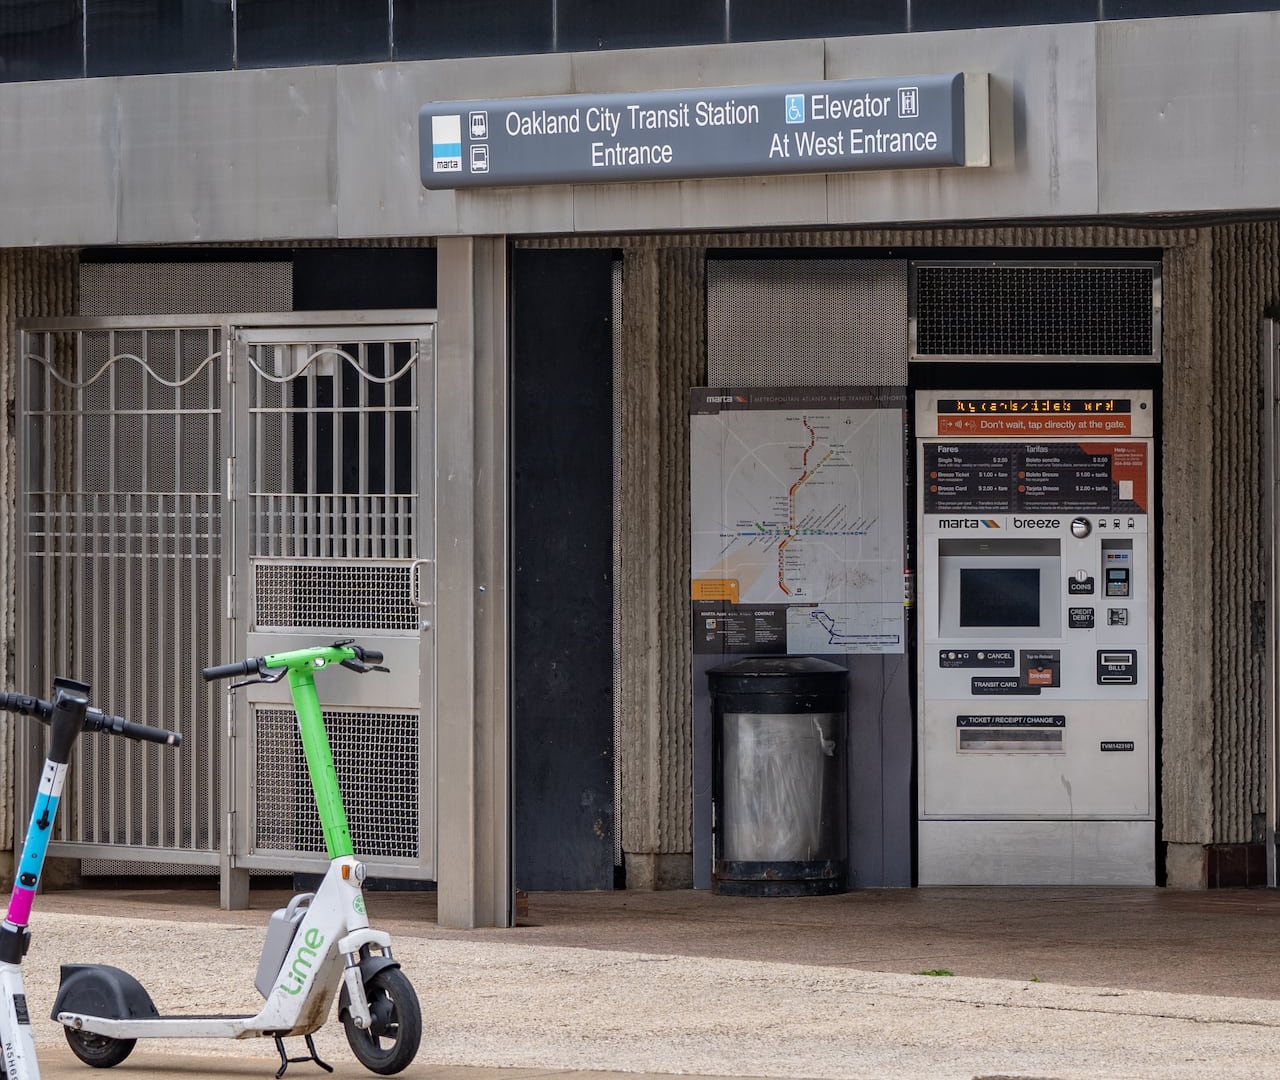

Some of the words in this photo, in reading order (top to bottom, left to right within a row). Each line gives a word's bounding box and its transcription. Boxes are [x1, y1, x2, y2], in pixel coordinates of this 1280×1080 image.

[811, 94, 891, 120] Elevator
[505, 108, 580, 136] Oakland
[585, 107, 621, 138] City
[627, 102, 690, 130] Transit
[695, 101, 759, 127] Station
[769, 133, 790, 159] At
[795, 130, 844, 157] West
[850, 128, 937, 155] Entrance
[591, 142, 673, 167] Entrance
[436, 158, 459, 170] marta
[706, 395, 733, 403] marta
[980, 420, 1003, 429] Don't
[1005, 421, 1026, 430] wait,
[1028, 421, 1043, 431] tap
[1045, 420, 1076, 430] directly
[1078, 421, 1087, 429] at
[1089, 420, 1102, 428] the
[1105, 421, 1127, 430] gate.
[938, 445, 959, 453] Fares
[1025, 445, 1049, 453] Tarifas
[939, 518, 979, 528] marta
[1013, 517, 1060, 529] breeze
